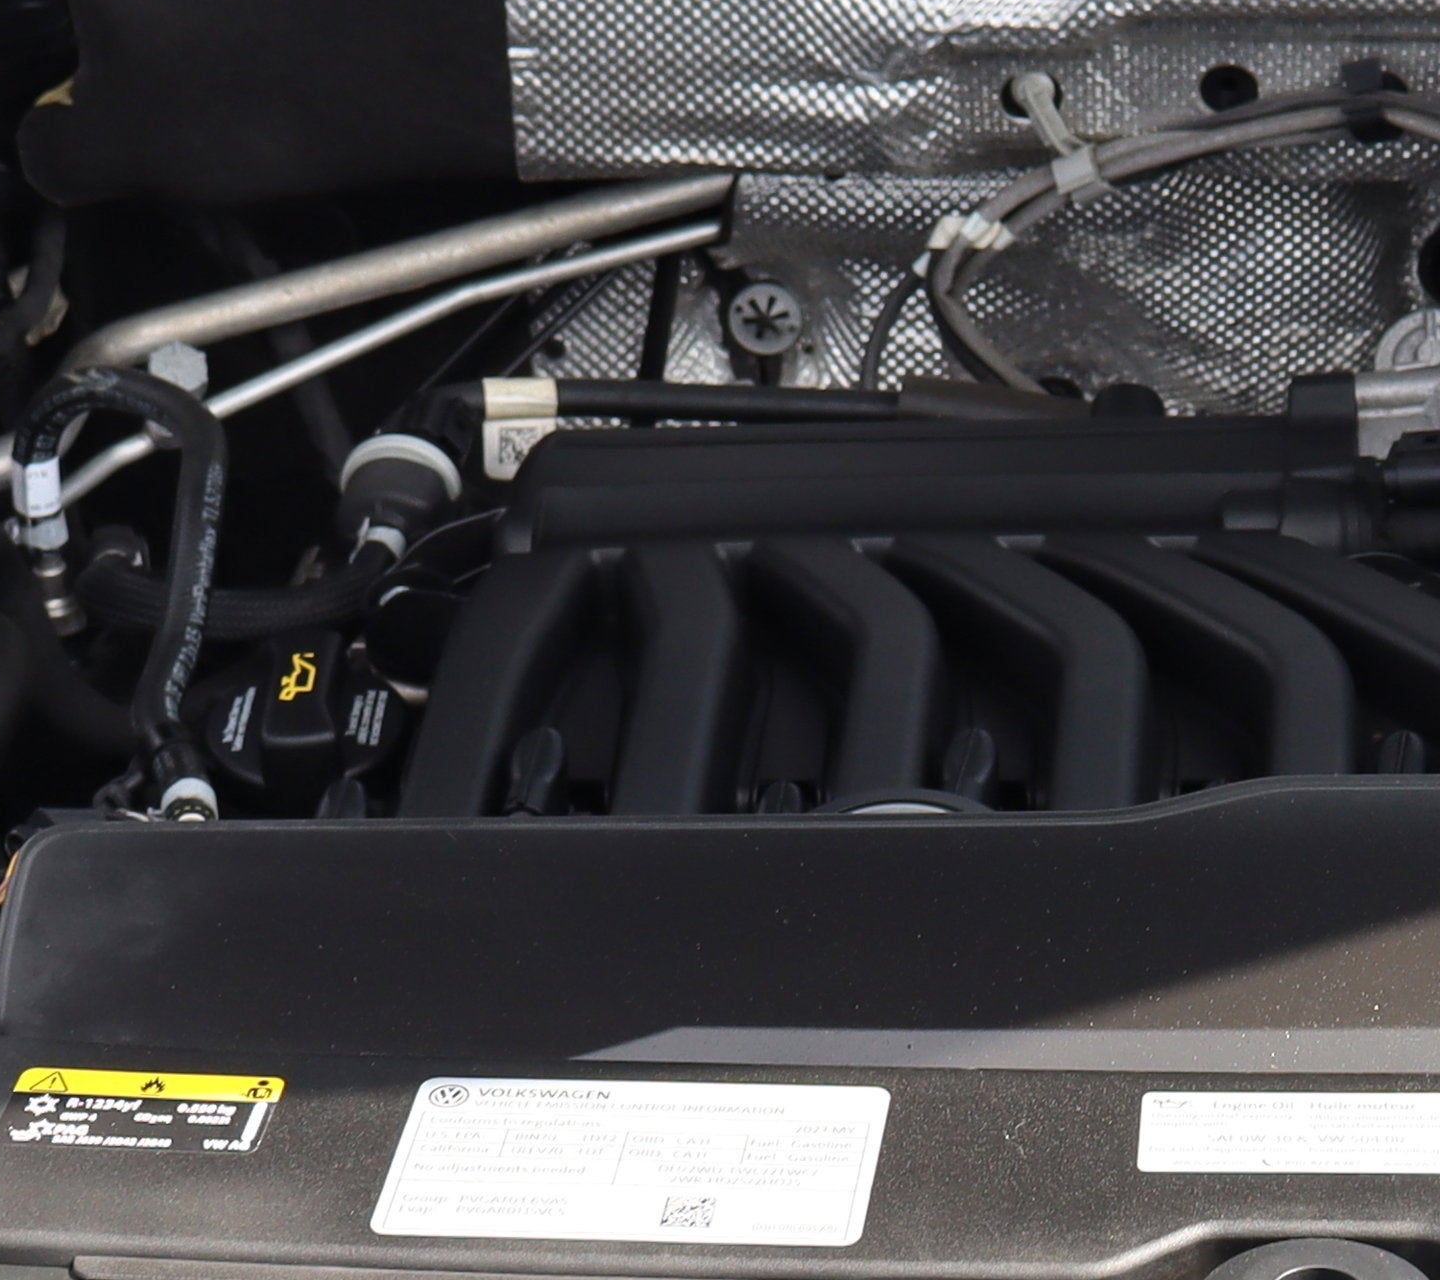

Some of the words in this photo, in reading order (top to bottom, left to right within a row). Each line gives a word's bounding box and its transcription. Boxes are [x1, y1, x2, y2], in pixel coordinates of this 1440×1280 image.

[479, 1087, 611, 1100] VOLKSWAGEN
[66, 1097, 142, 1112] R-1234yf
[475, 1099, 530, 1109] VEHICLE
[537, 1101, 606, 1111] EMISSION
[611, 1103, 677, 1112] CONTROL
[683, 1104, 785, 1114] INFORMATION
[1213, 1101, 1266, 1111] Engine
[1271, 1101, 1295, 1110] Oil
[1310, 1101, 1352, 1110] Huile
[1357, 1102, 1415, 1111] moteur
[203, 1139, 229, 1150] VW
[1318, 1135, 1345, 1144] VW
